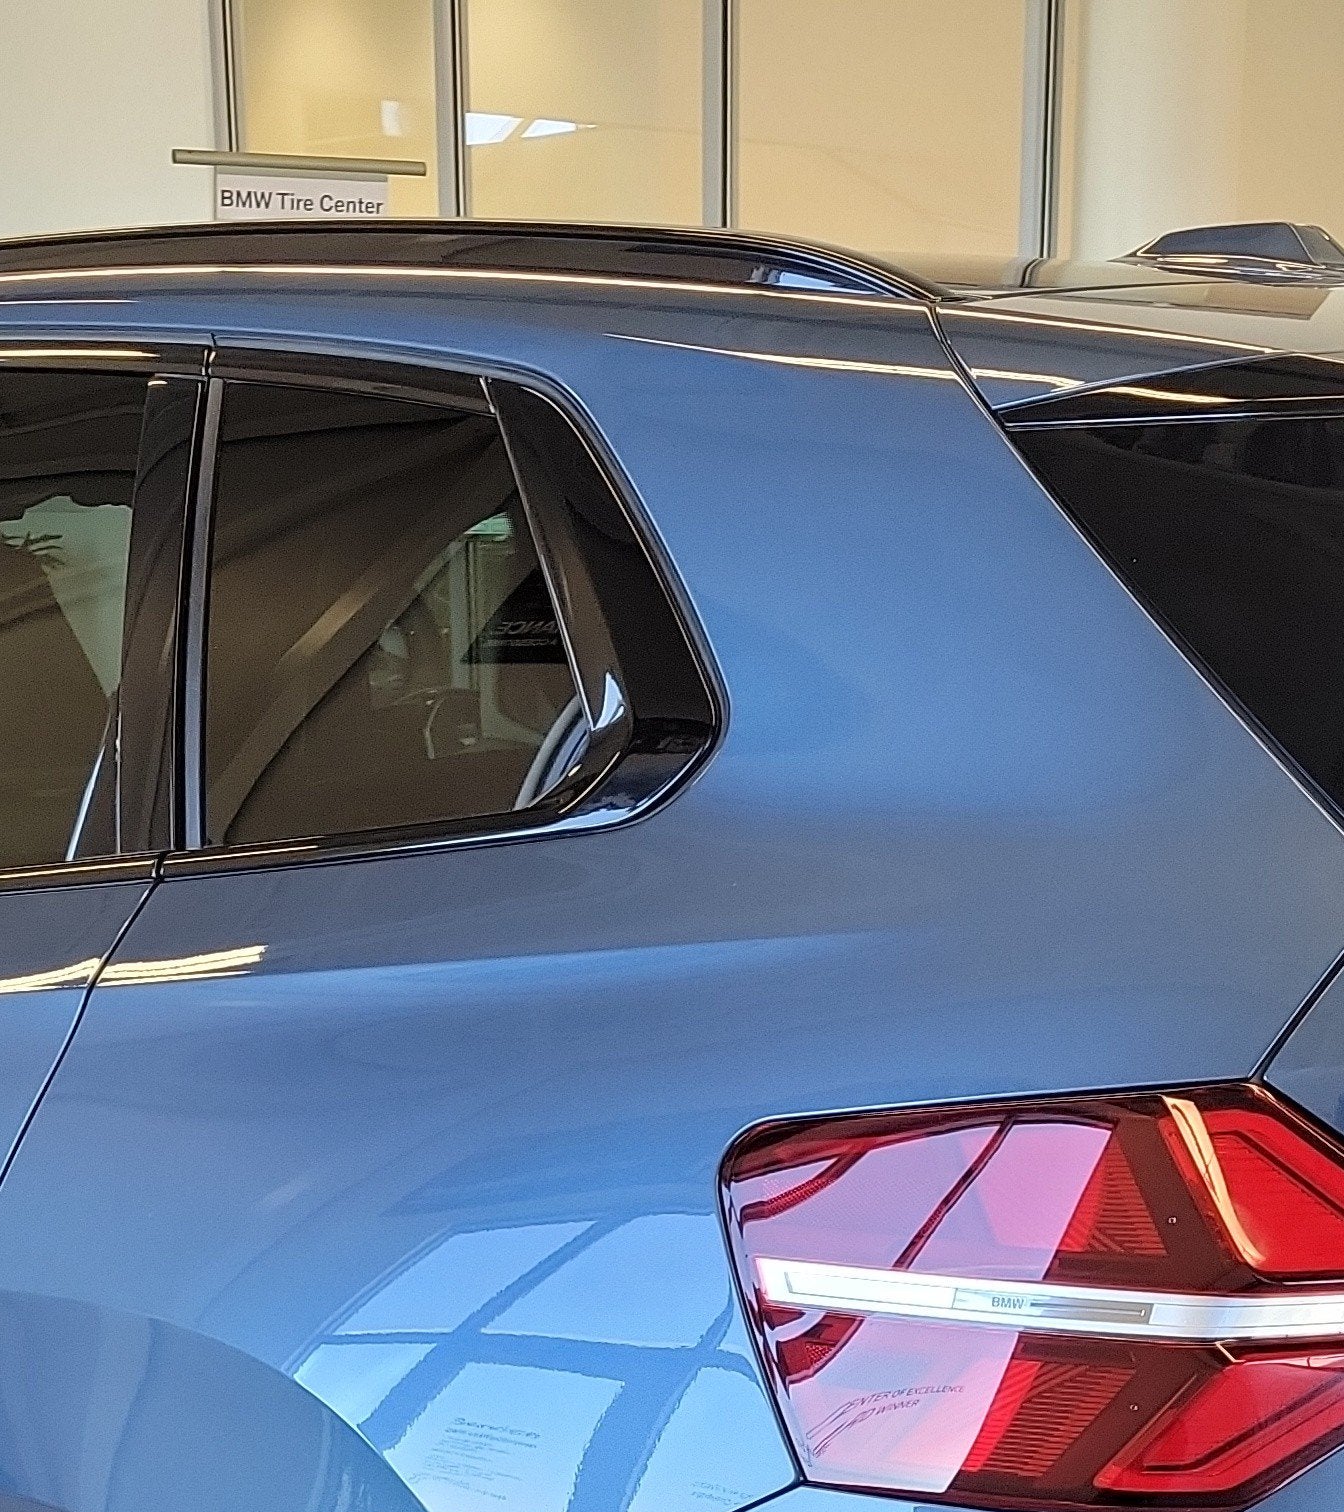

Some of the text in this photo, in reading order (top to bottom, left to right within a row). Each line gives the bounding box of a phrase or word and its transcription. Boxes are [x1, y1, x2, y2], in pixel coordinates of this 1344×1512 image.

[220, 189, 385, 215] BMW Tire Center
[991, 1295, 1026, 1310] BMW
[906, 1385, 965, 1397] EXCELLENCE
